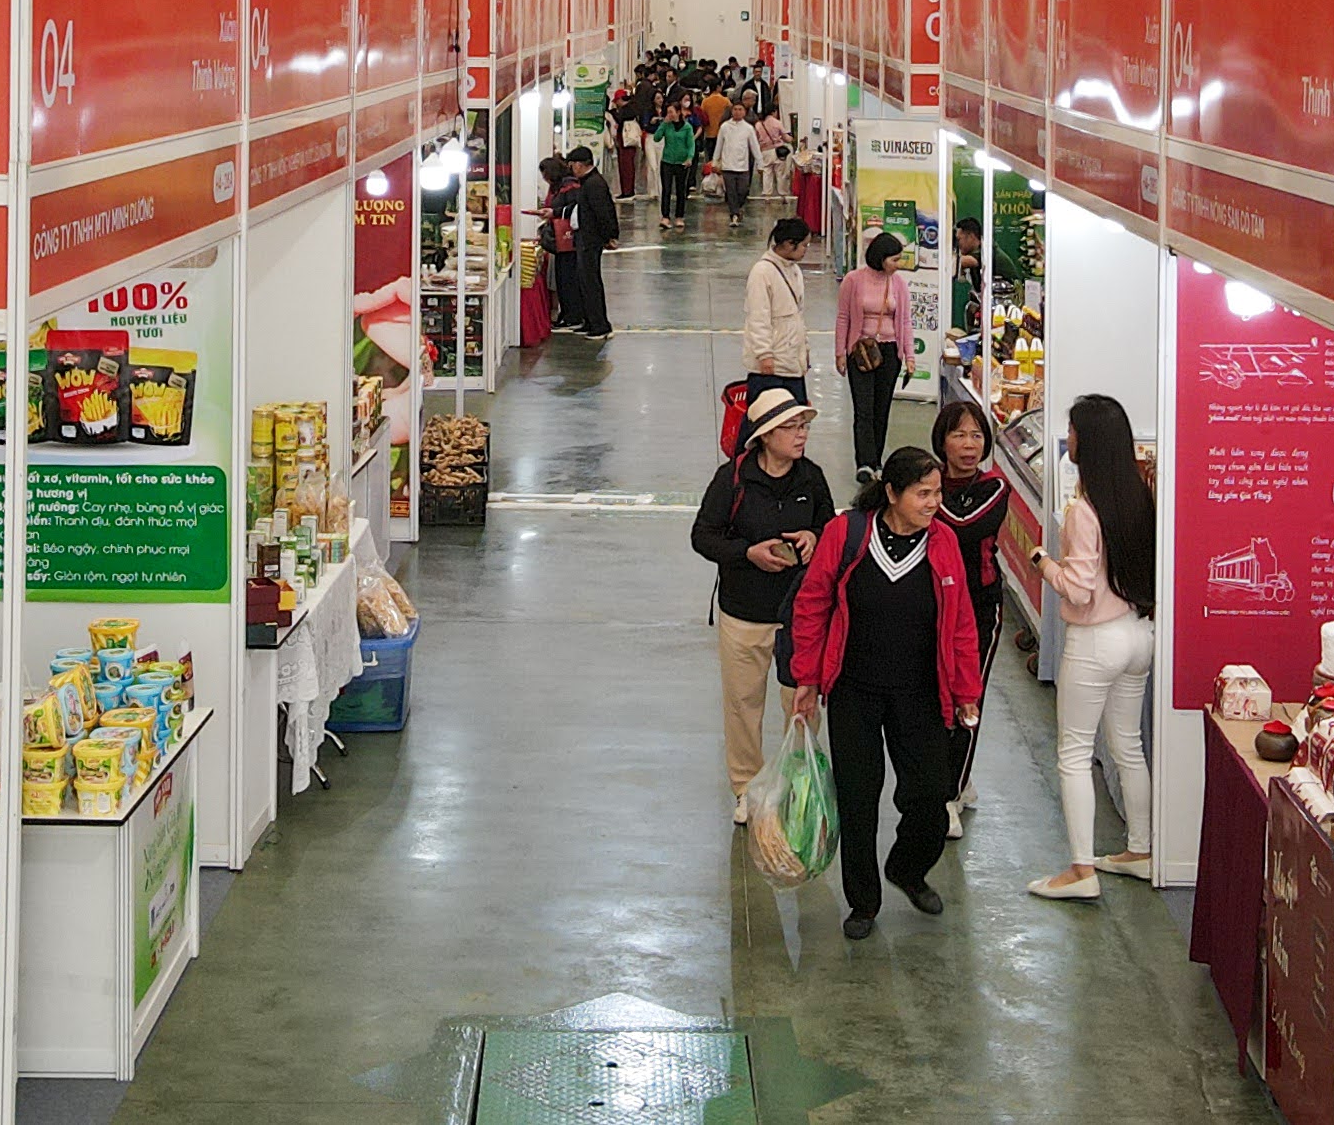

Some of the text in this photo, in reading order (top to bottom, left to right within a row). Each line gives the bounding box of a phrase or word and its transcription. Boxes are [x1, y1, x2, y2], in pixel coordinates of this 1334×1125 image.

[40, 18, 76, 108] 04
[1171, 20, 1194, 90] 04
[1301, 76, 1330, 125] Thịnh
[882, 139, 934, 156] VINASEED
[369, 214, 397, 226] TIN
